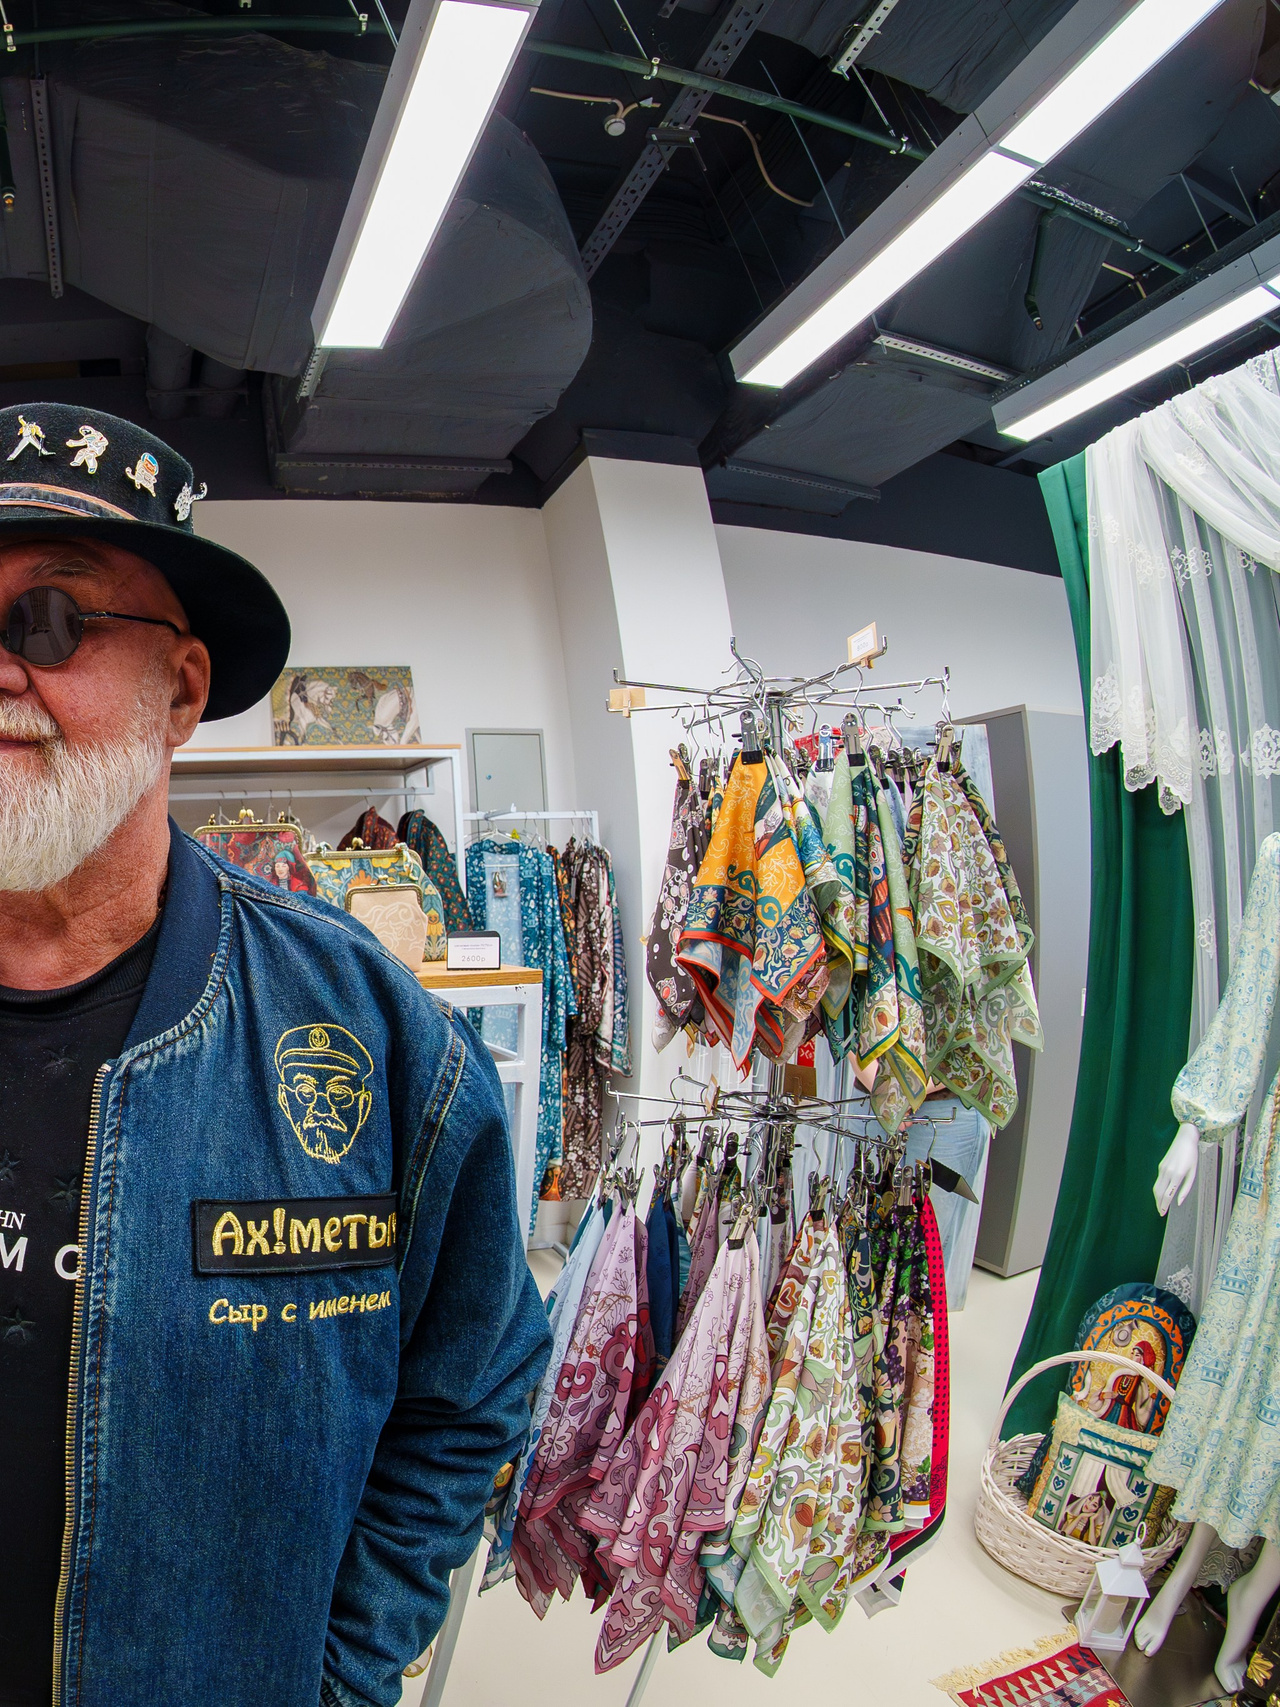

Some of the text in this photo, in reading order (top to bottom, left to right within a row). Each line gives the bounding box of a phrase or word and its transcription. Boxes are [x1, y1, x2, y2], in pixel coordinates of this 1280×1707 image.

[209, 1290, 392, 1332] Сыр с именем
